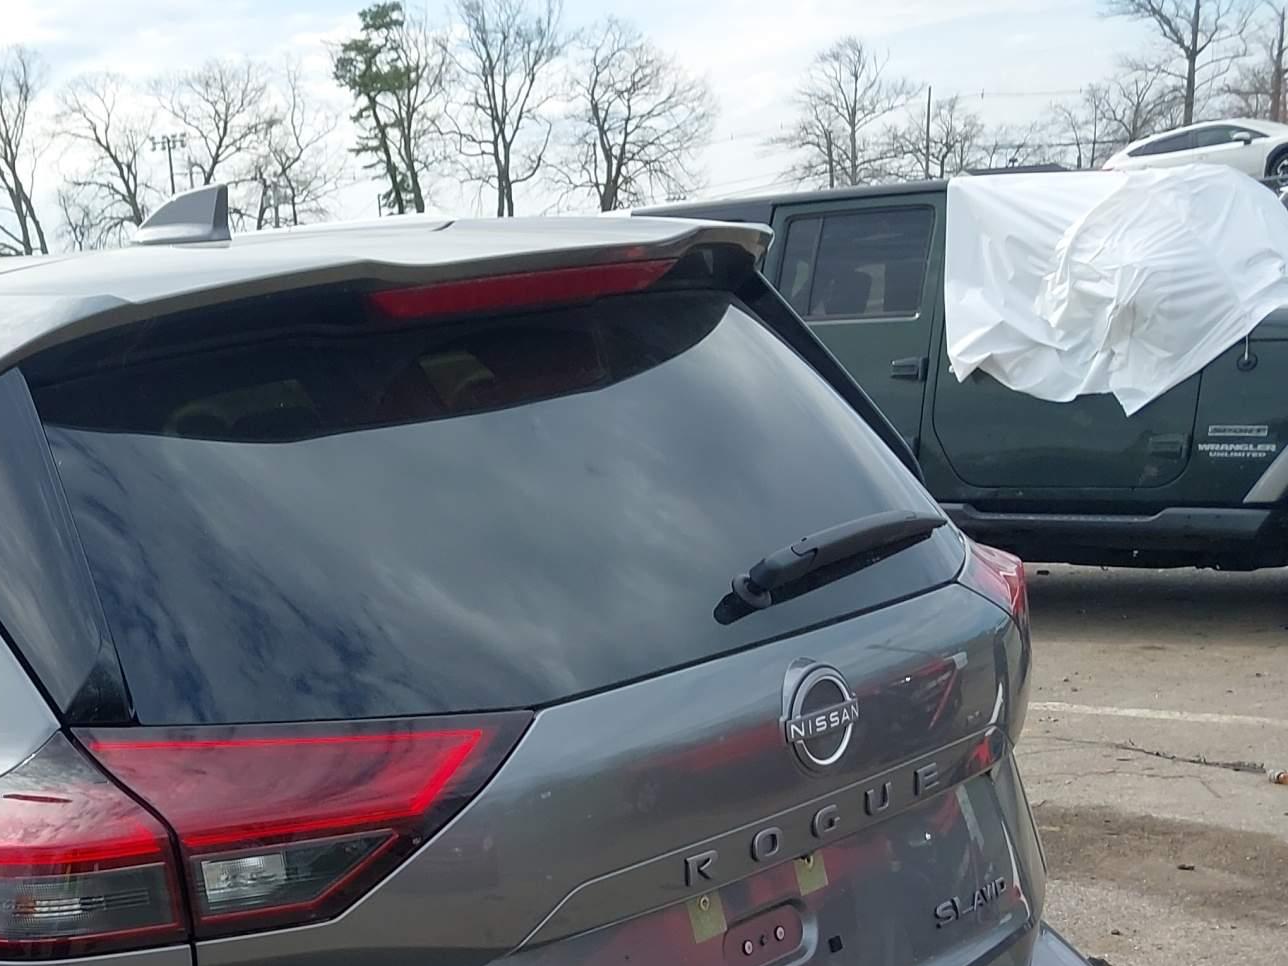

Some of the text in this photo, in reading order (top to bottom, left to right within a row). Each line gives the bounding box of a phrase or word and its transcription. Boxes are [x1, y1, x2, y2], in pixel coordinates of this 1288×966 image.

[1198, 443, 1276, 452] WRANGLER
[790, 702, 859, 739] NISSAN
[684, 762, 939, 888] ROGUE
